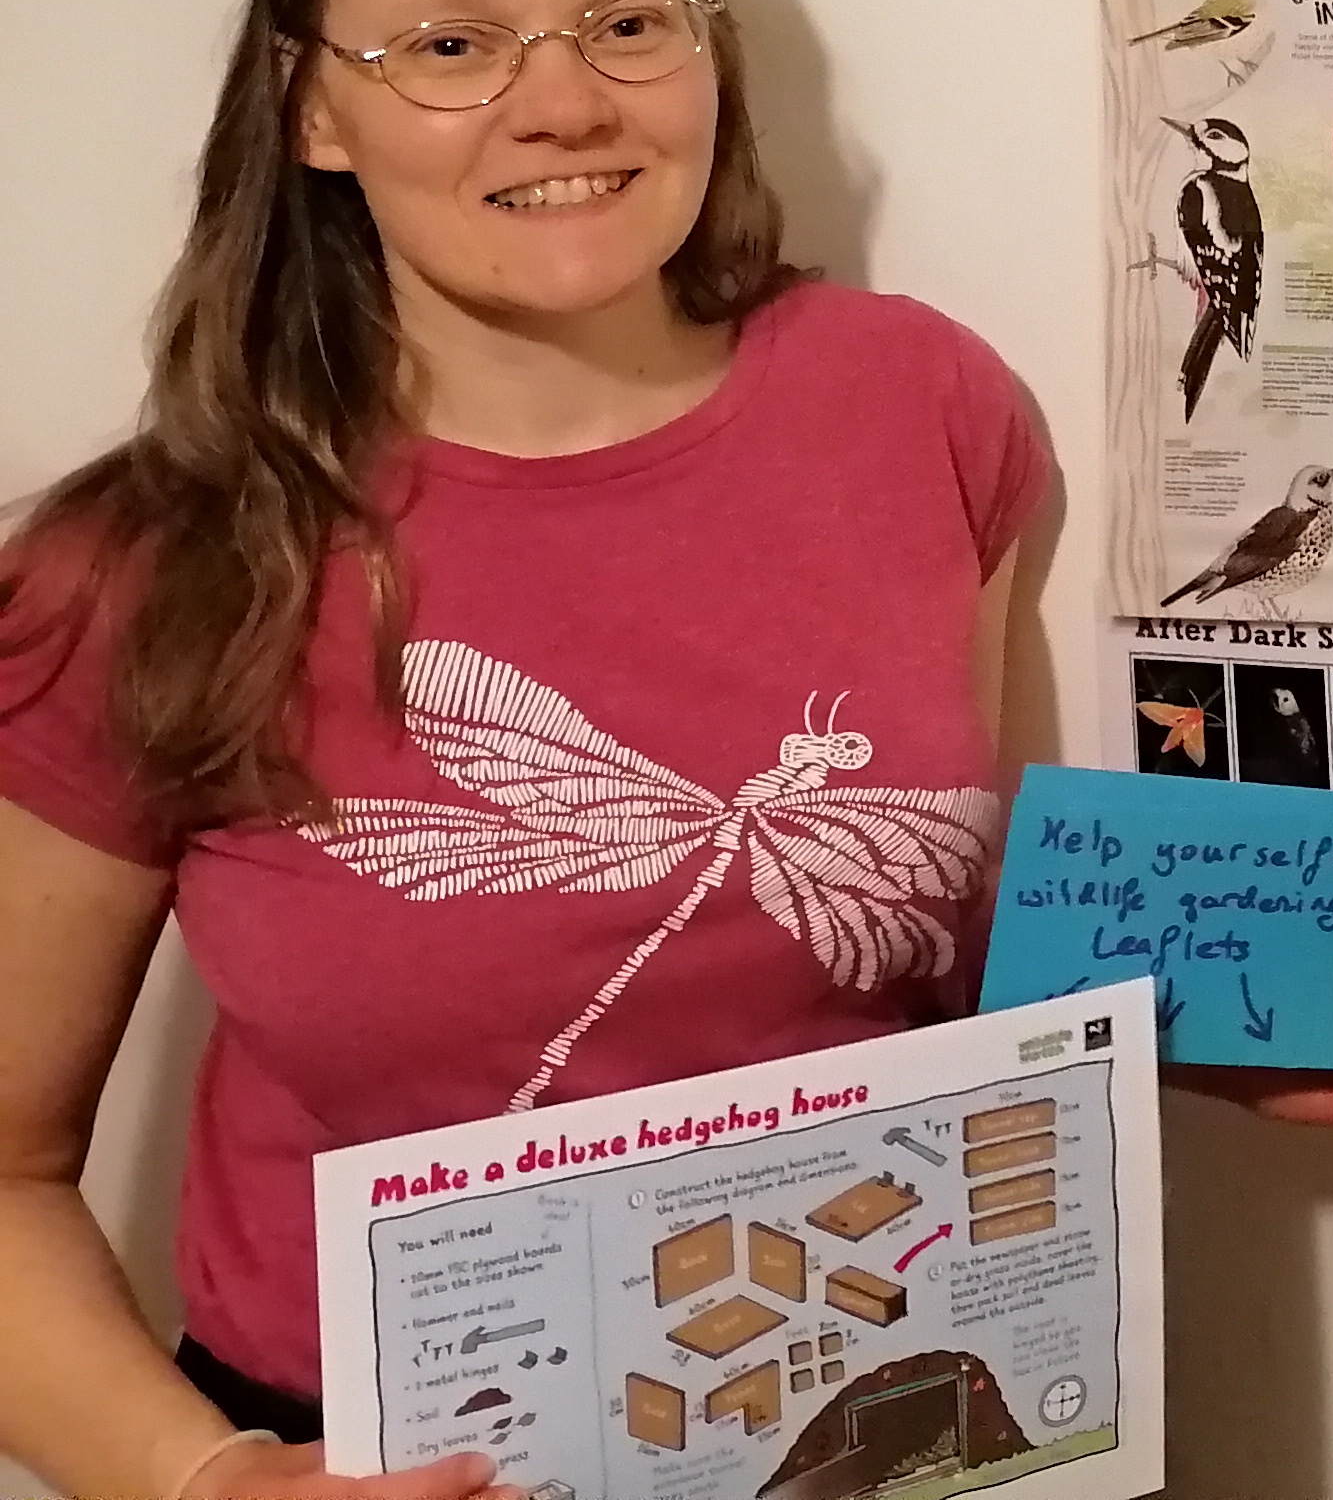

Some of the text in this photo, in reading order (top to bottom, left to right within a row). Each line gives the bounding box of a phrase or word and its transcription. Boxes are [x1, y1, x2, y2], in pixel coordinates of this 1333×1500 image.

[1135, 617, 1216, 642] After
[1228, 619, 1307, 648] Dark
[1151, 836, 1333, 886] yourself
[1016, 878, 1146, 922] wildlife
[370, 1084, 869, 1207] Make a deluxe hedgehog house
